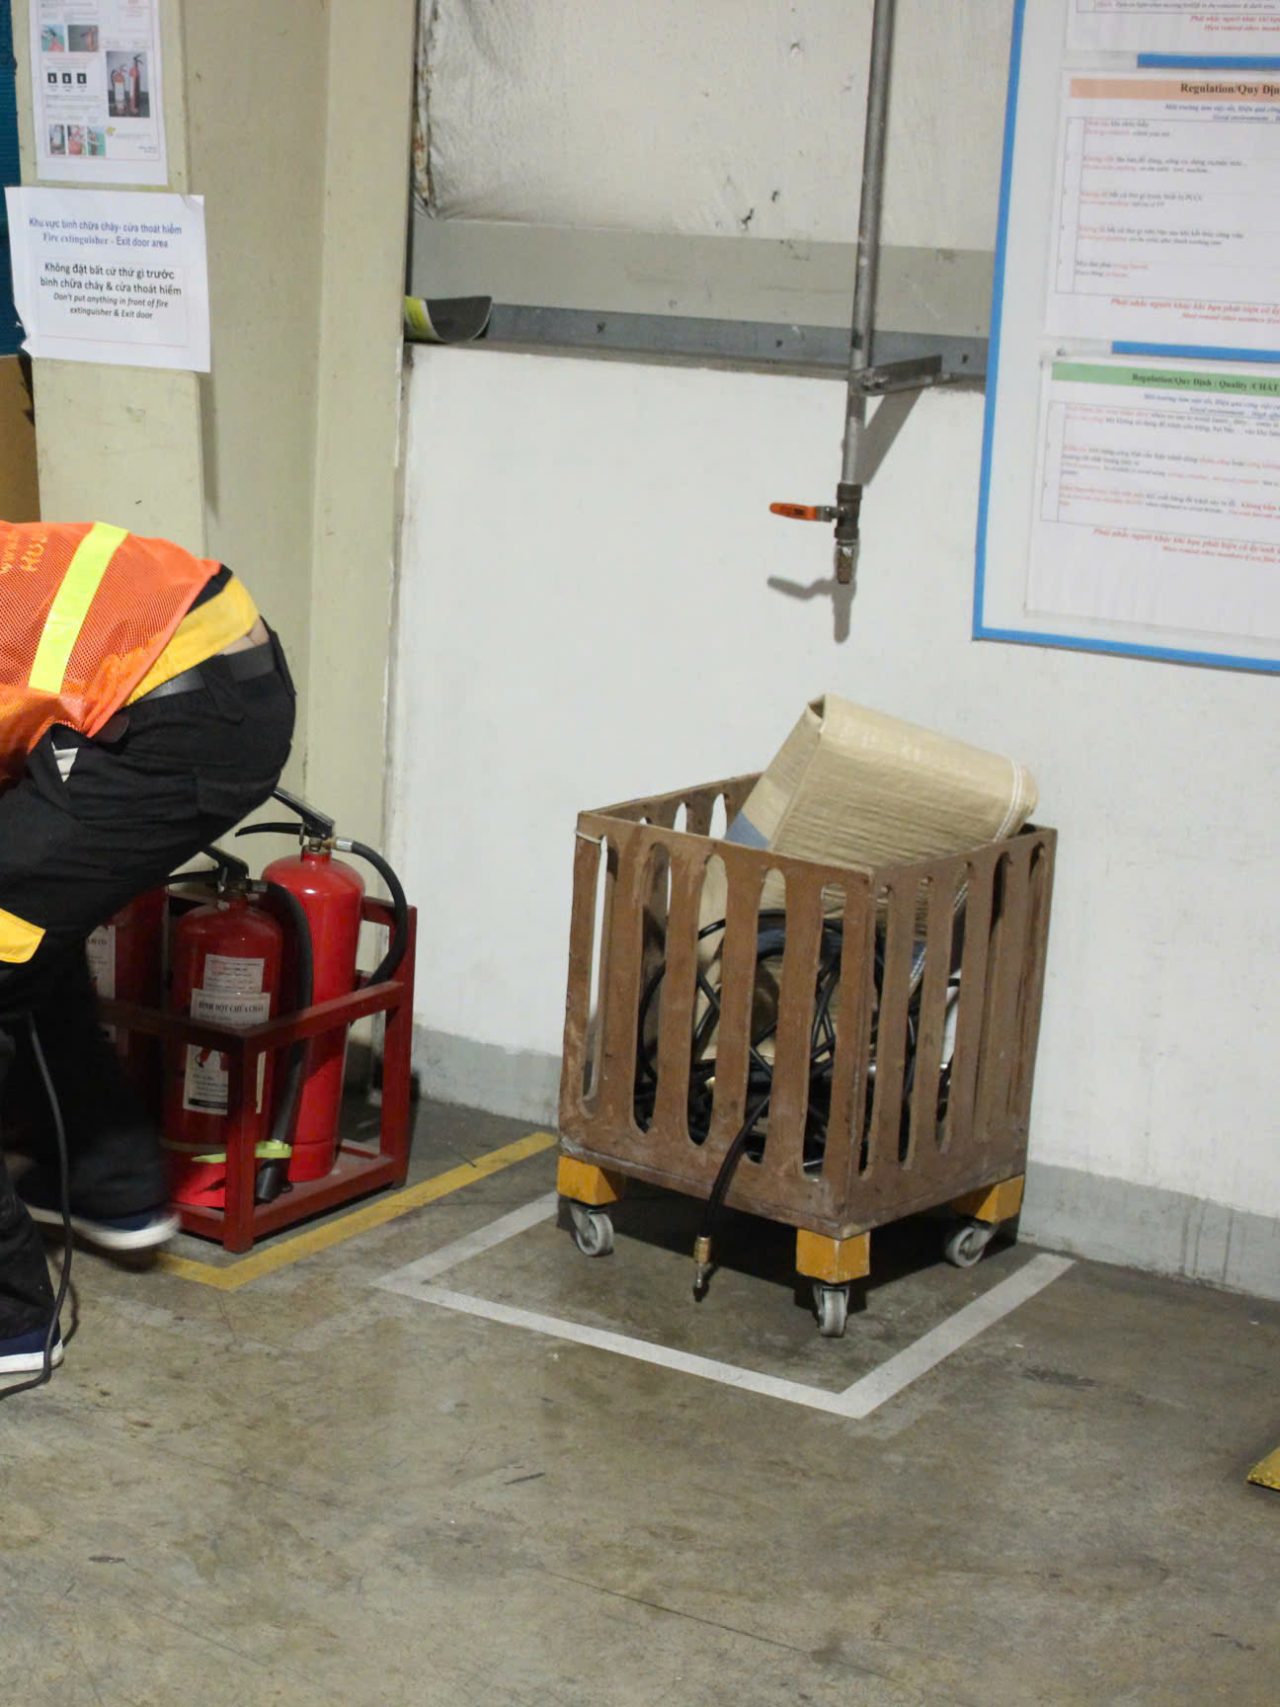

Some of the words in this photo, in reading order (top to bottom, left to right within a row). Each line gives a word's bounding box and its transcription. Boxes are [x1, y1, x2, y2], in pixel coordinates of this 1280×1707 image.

[43, 232, 58, 242] Fire
[60, 234, 108, 246] extinguisher
[116, 236, 131, 246] Exit
[132, 237, 149, 247] door
[151, 239, 168, 248] area
[45, 262, 70, 275] Không
[146, 268, 175, 280] trước
[106, 281, 113, 291] &
[53, 292, 72, 301] Don't
[73, 295, 86, 303] put
[87, 295, 118, 306] anything
[127, 298, 146, 307] front
[147, 299, 155, 308] of
[156, 299, 169, 308] fire
[70, 307, 112, 317] extinguisher
[113, 308, 119, 317] &
[121, 309, 135, 317] Exit
[136, 310, 153, 319] door
